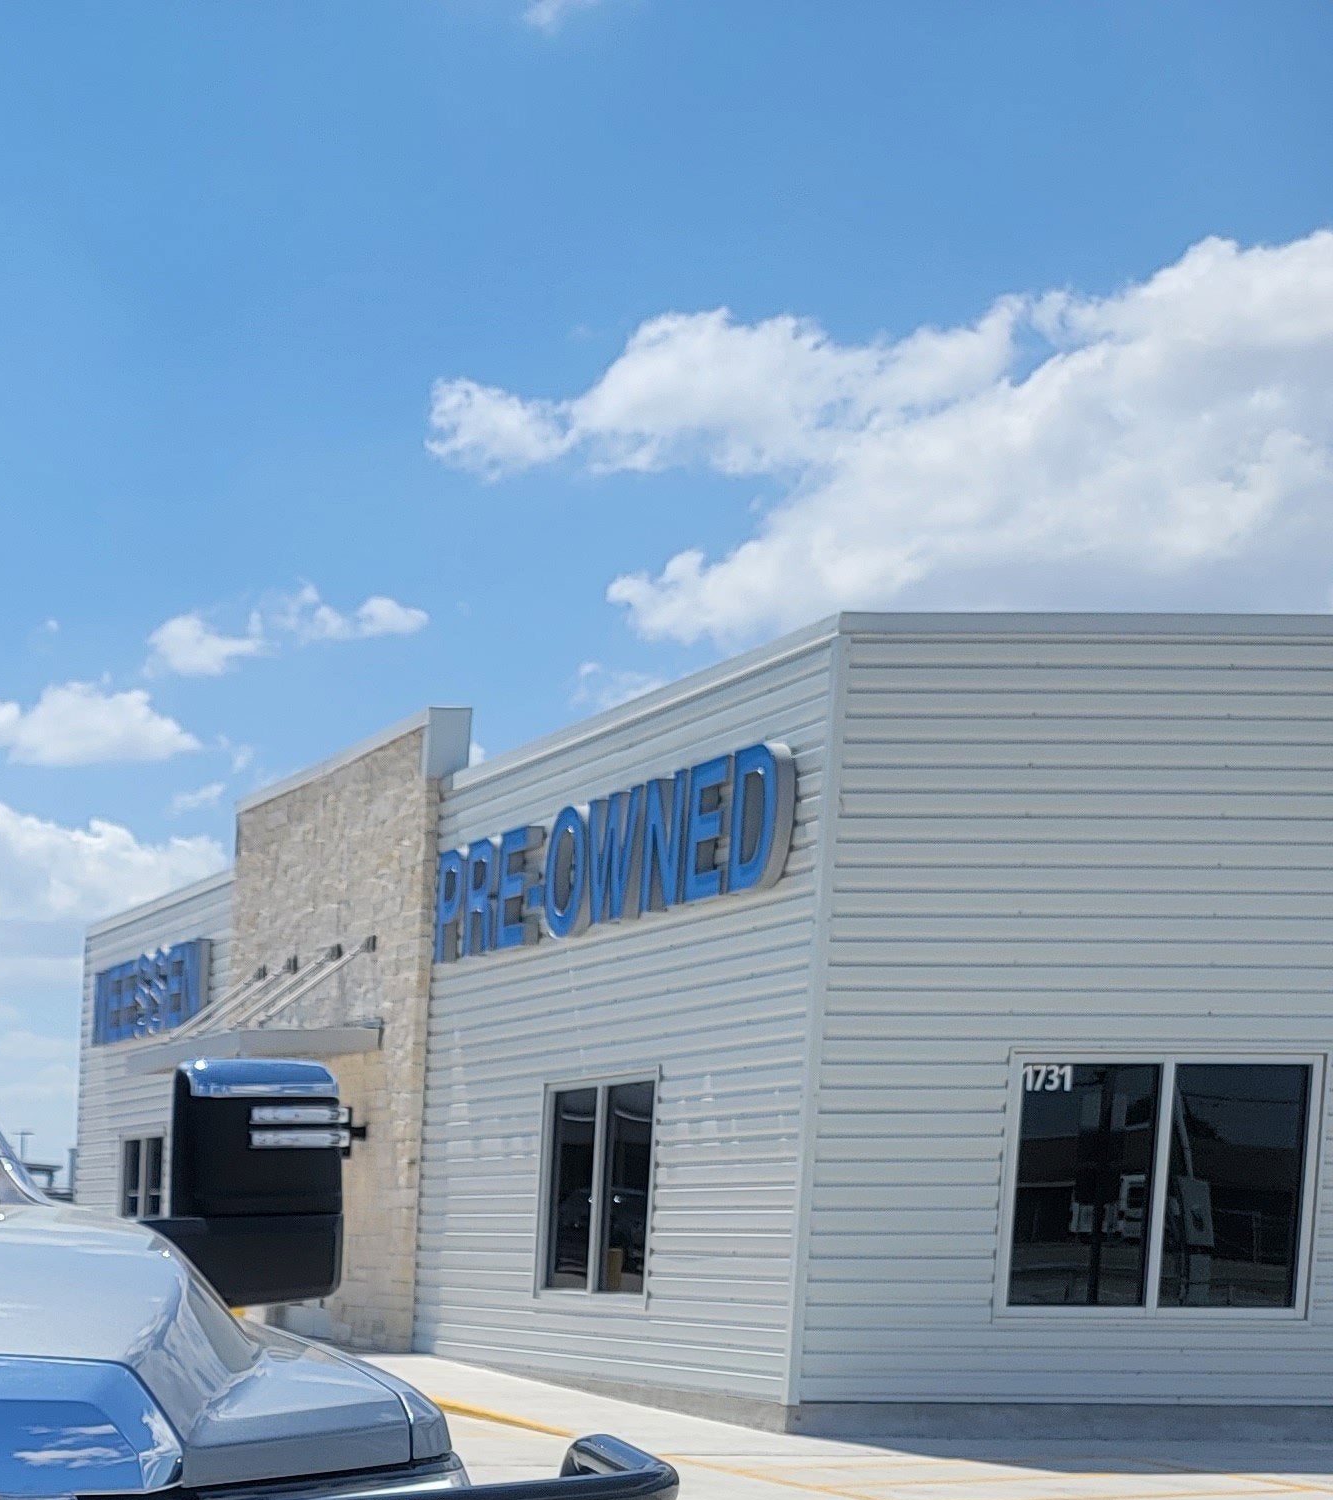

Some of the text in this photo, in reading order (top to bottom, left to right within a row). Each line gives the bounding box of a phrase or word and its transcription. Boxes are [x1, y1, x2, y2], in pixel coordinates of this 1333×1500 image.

[434, 743, 793, 962] PRE-OWNED
[91, 939, 205, 1046] NEESSEN
[1023, 1064, 1072, 1092] 1731
